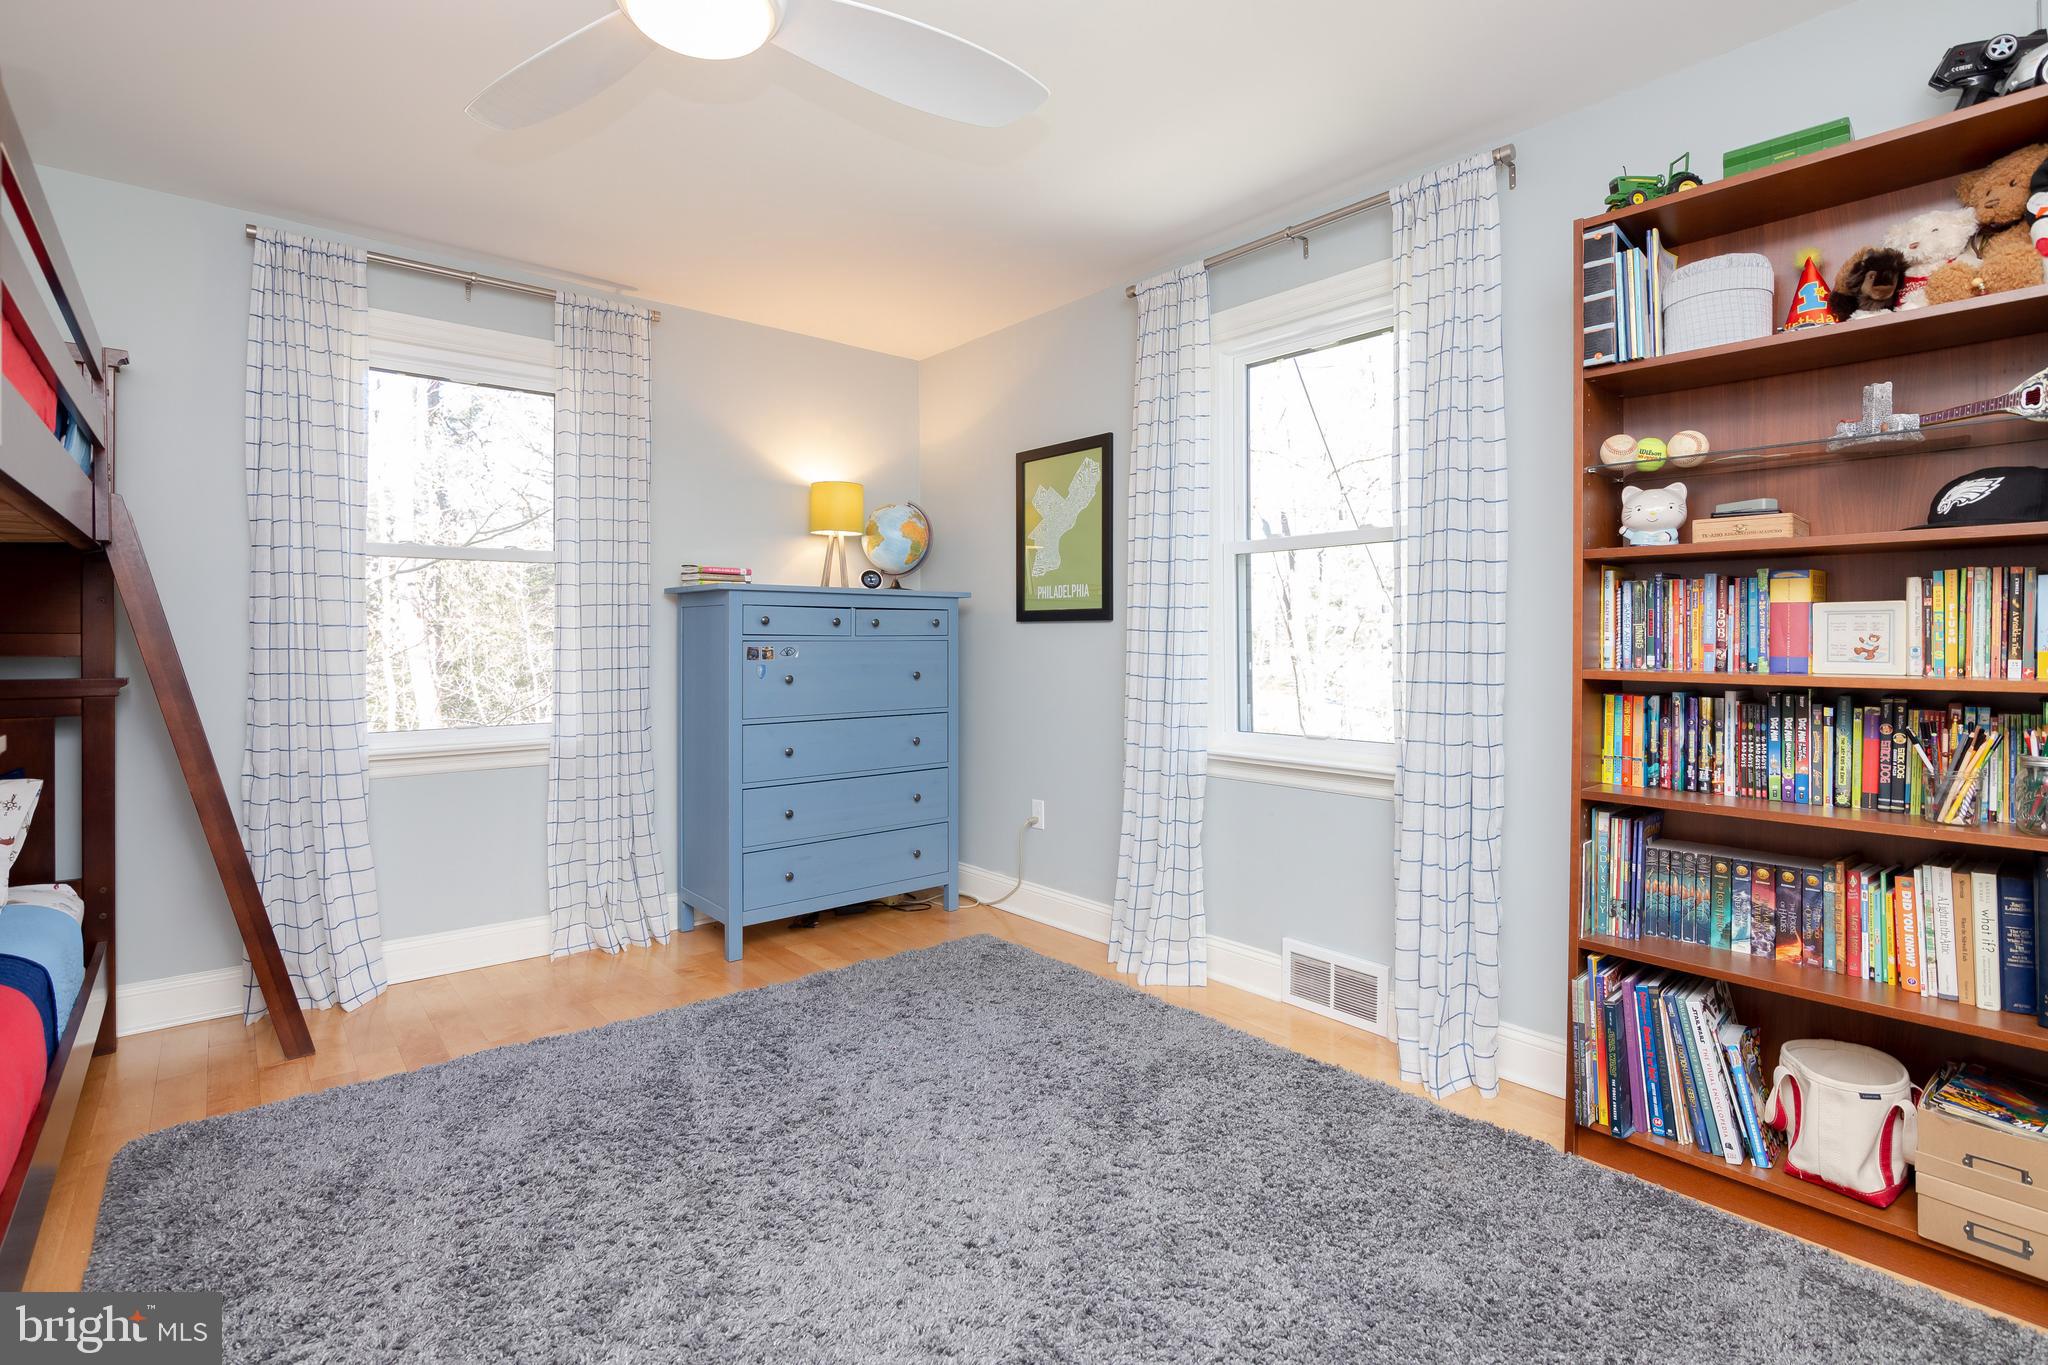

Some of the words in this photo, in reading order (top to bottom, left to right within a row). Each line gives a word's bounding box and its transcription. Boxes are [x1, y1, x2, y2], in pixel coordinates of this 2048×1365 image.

[1639, 448, 1662, 456] Wilson
[1037, 583, 1089, 599] PHILADELPHIA
[1624, 603, 1632, 628] GAMER
[1624, 631, 1632, 651] ARMY
[1635, 624, 1644, 648] TUNNELS
[1770, 718, 1778, 729] DOG
[1784, 718, 1793, 729] DOG
[1798, 718, 1806, 730] DOG
[1770, 730, 1778, 741] MAN
[1784, 730, 1792, 741] MAN
[1798, 730, 1806, 742] MAN
[1880, 740, 1891, 762] STICK
[1880, 764, 1891, 784] DOG
[1897, 765, 1905, 779] DOG
[1716, 891, 1725, 910] LOST
[1902, 891, 1912, 910] DID
[1936, 902, 1950, 919] Light
[1778, 908, 1787, 933] HADES
[1788, 912, 1797, 935] HOUSE
[1805, 908, 1814, 940] OLYMPUS
[1903, 913, 1914, 932] YOU
[1940, 919, 1949, 927] in
[1981, 910, 1995, 935] what
[1941, 927, 1950, 938] the
[1905, 934, 1916, 968] KNOW?
[1941, 939, 1951, 954] Attic
[1982, 939, 1995, 954] if?
[1692, 1007, 1702, 1025] STAR
[1695, 1025, 1705, 1044] WARS
[1703, 1048, 1711, 1060] THE
[1609, 1052, 1617, 1077] WARS
[1687, 1037, 1696, 1053] BOOK
[1694, 1063, 1703, 1085] NORSE
[1700, 1088, 1709, 1110] MYTHS
[1706, 1063, 1716, 1086] VISUAL
[1712, 1088, 1728, 1138] ENCYCLOPEDIA
